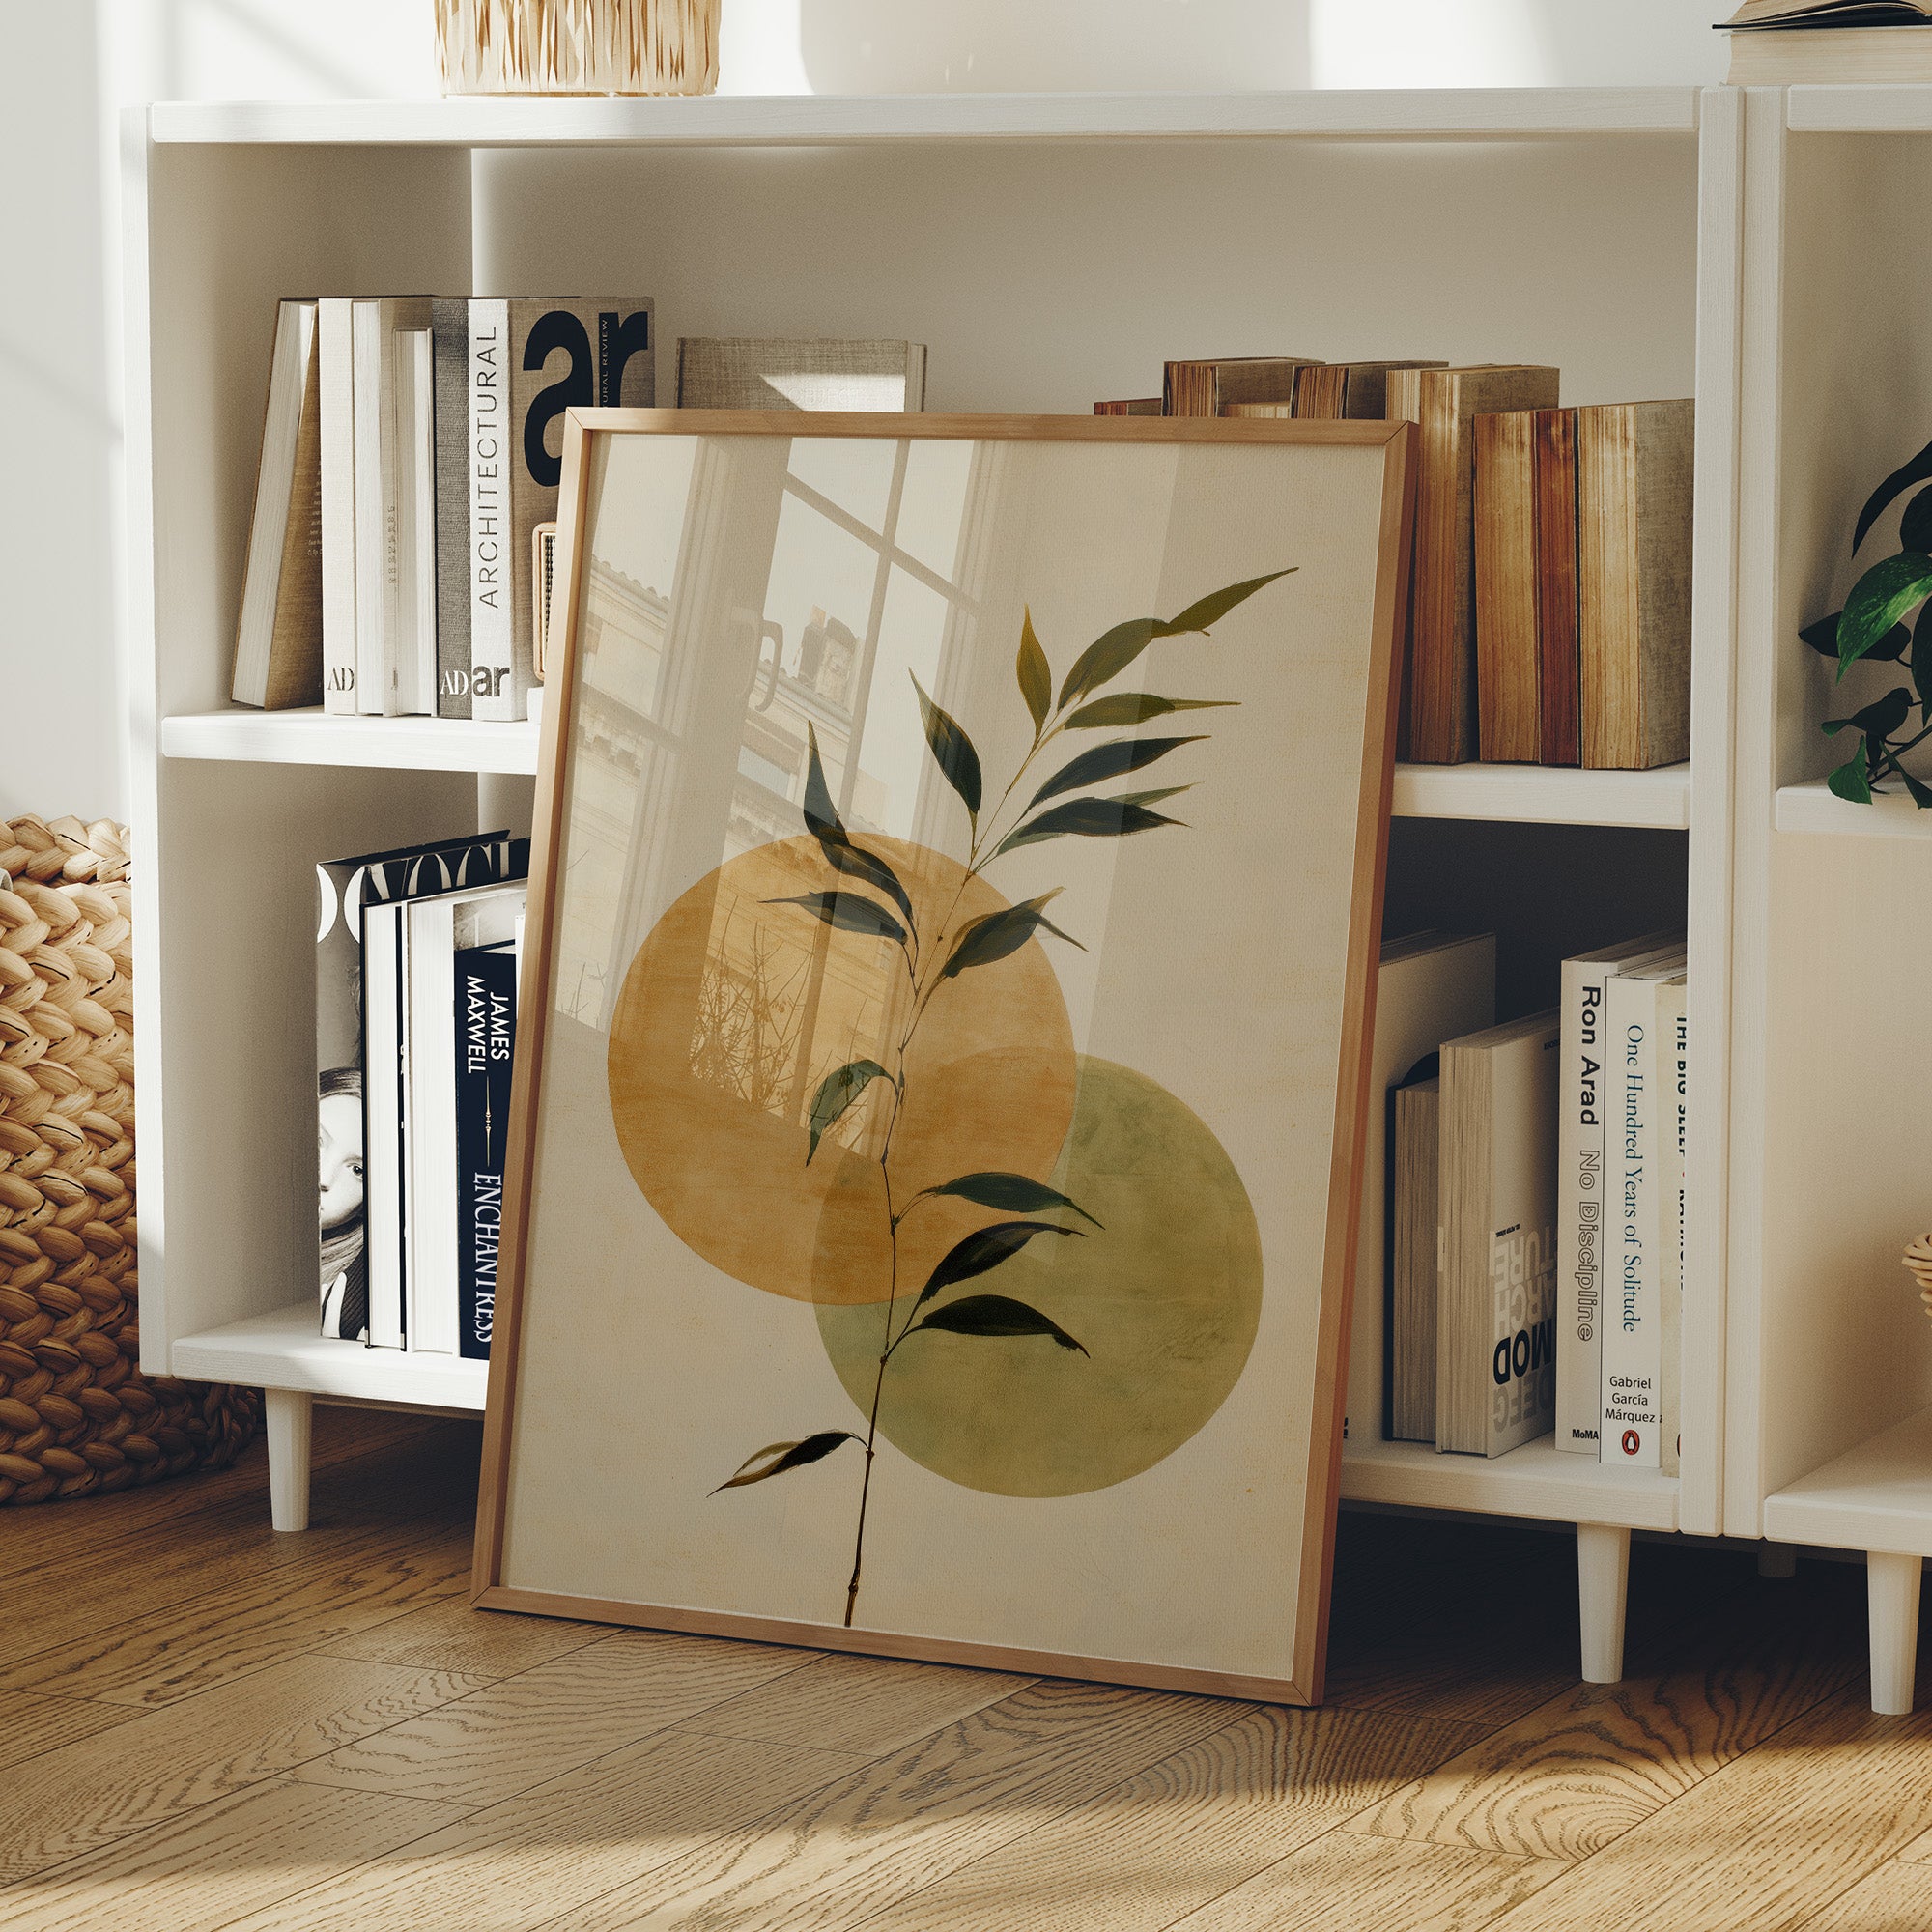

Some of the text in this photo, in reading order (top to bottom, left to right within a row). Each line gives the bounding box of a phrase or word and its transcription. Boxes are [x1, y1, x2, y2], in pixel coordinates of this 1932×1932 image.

[477, 327, 498, 609] ARCHITECTURAL
[327, 667, 355, 691] AD
[440, 670, 469, 696] AD
[472, 665, 510, 697] ar
[467, 975, 486, 1074] MAXWELL
[490, 991, 510, 1061] JAMES
[1575, 986, 1601, 1342] Ron Arad No Discipline
[1623, 1025, 1644, 1333] One Hundred Years of Solitude
[1609, 1376, 1652, 1390] Gabriel
[1611, 1392, 1648, 1406] García
[1605, 1408, 1655, 1423] Márquez
[1572, 1429, 1599, 1439] MoMA
